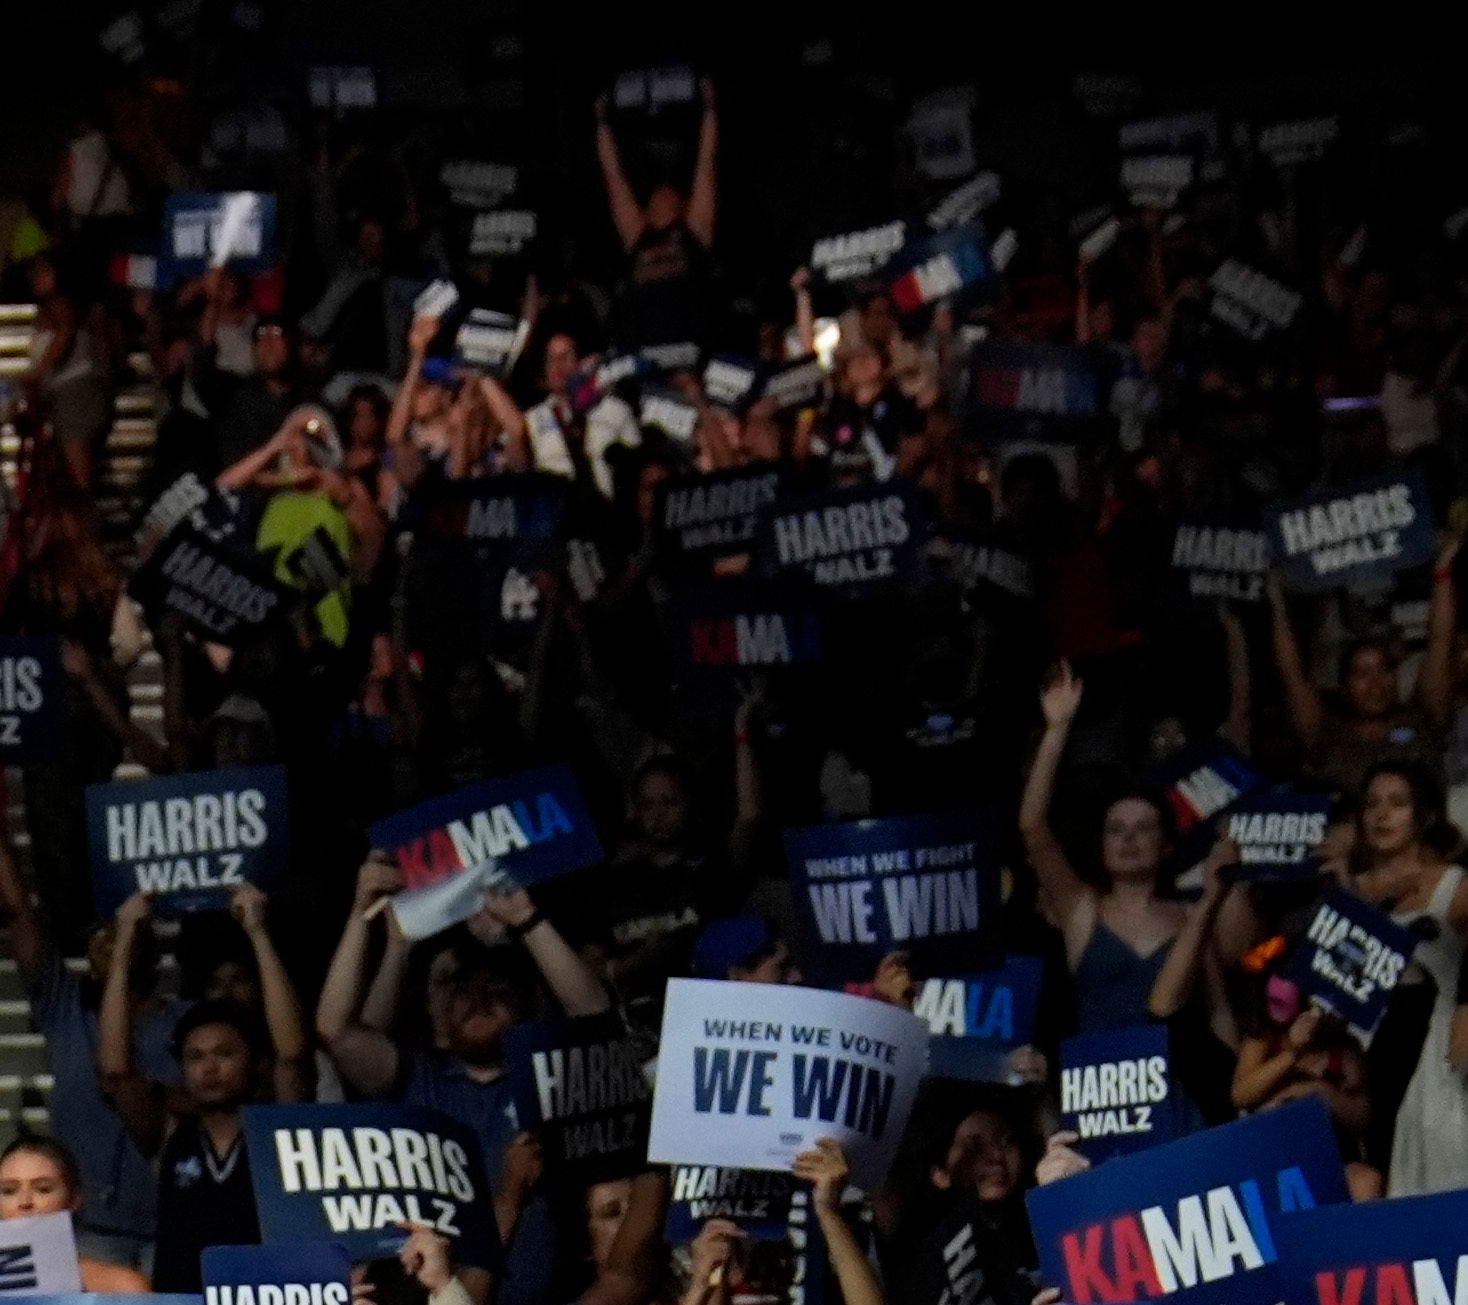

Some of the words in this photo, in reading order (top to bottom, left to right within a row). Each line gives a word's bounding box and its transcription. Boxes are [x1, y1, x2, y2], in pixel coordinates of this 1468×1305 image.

[1278, 482, 1418, 557] HARRIS
[106, 788, 269, 863] HARRIS
[1229, 811, 1329, 848] HARRIS
[135, 854, 244, 894] WALZ
[805, 855, 870, 880] WHEN
[872, 850, 913, 874] WE
[916, 842, 978, 870] FIGHT
[808, 879, 878, 945] WE
[881, 868, 980, 940] WIN
[703, 1018, 781, 1043] WHEN
[790, 1025, 832, 1048] WE
[839, 1030, 899, 1066] VOTE
[692, 1046, 778, 1119] WE
[792, 1048, 896, 1142] WIN
[1061, 1055, 1169, 1114] HARRIS
[1077, 1105, 1153, 1138] WALZ
[275, 1125, 476, 1203] HARRIS
[322, 1196, 461, 1236] WALZ
[689, 1198, 768, 1220] WALZ
